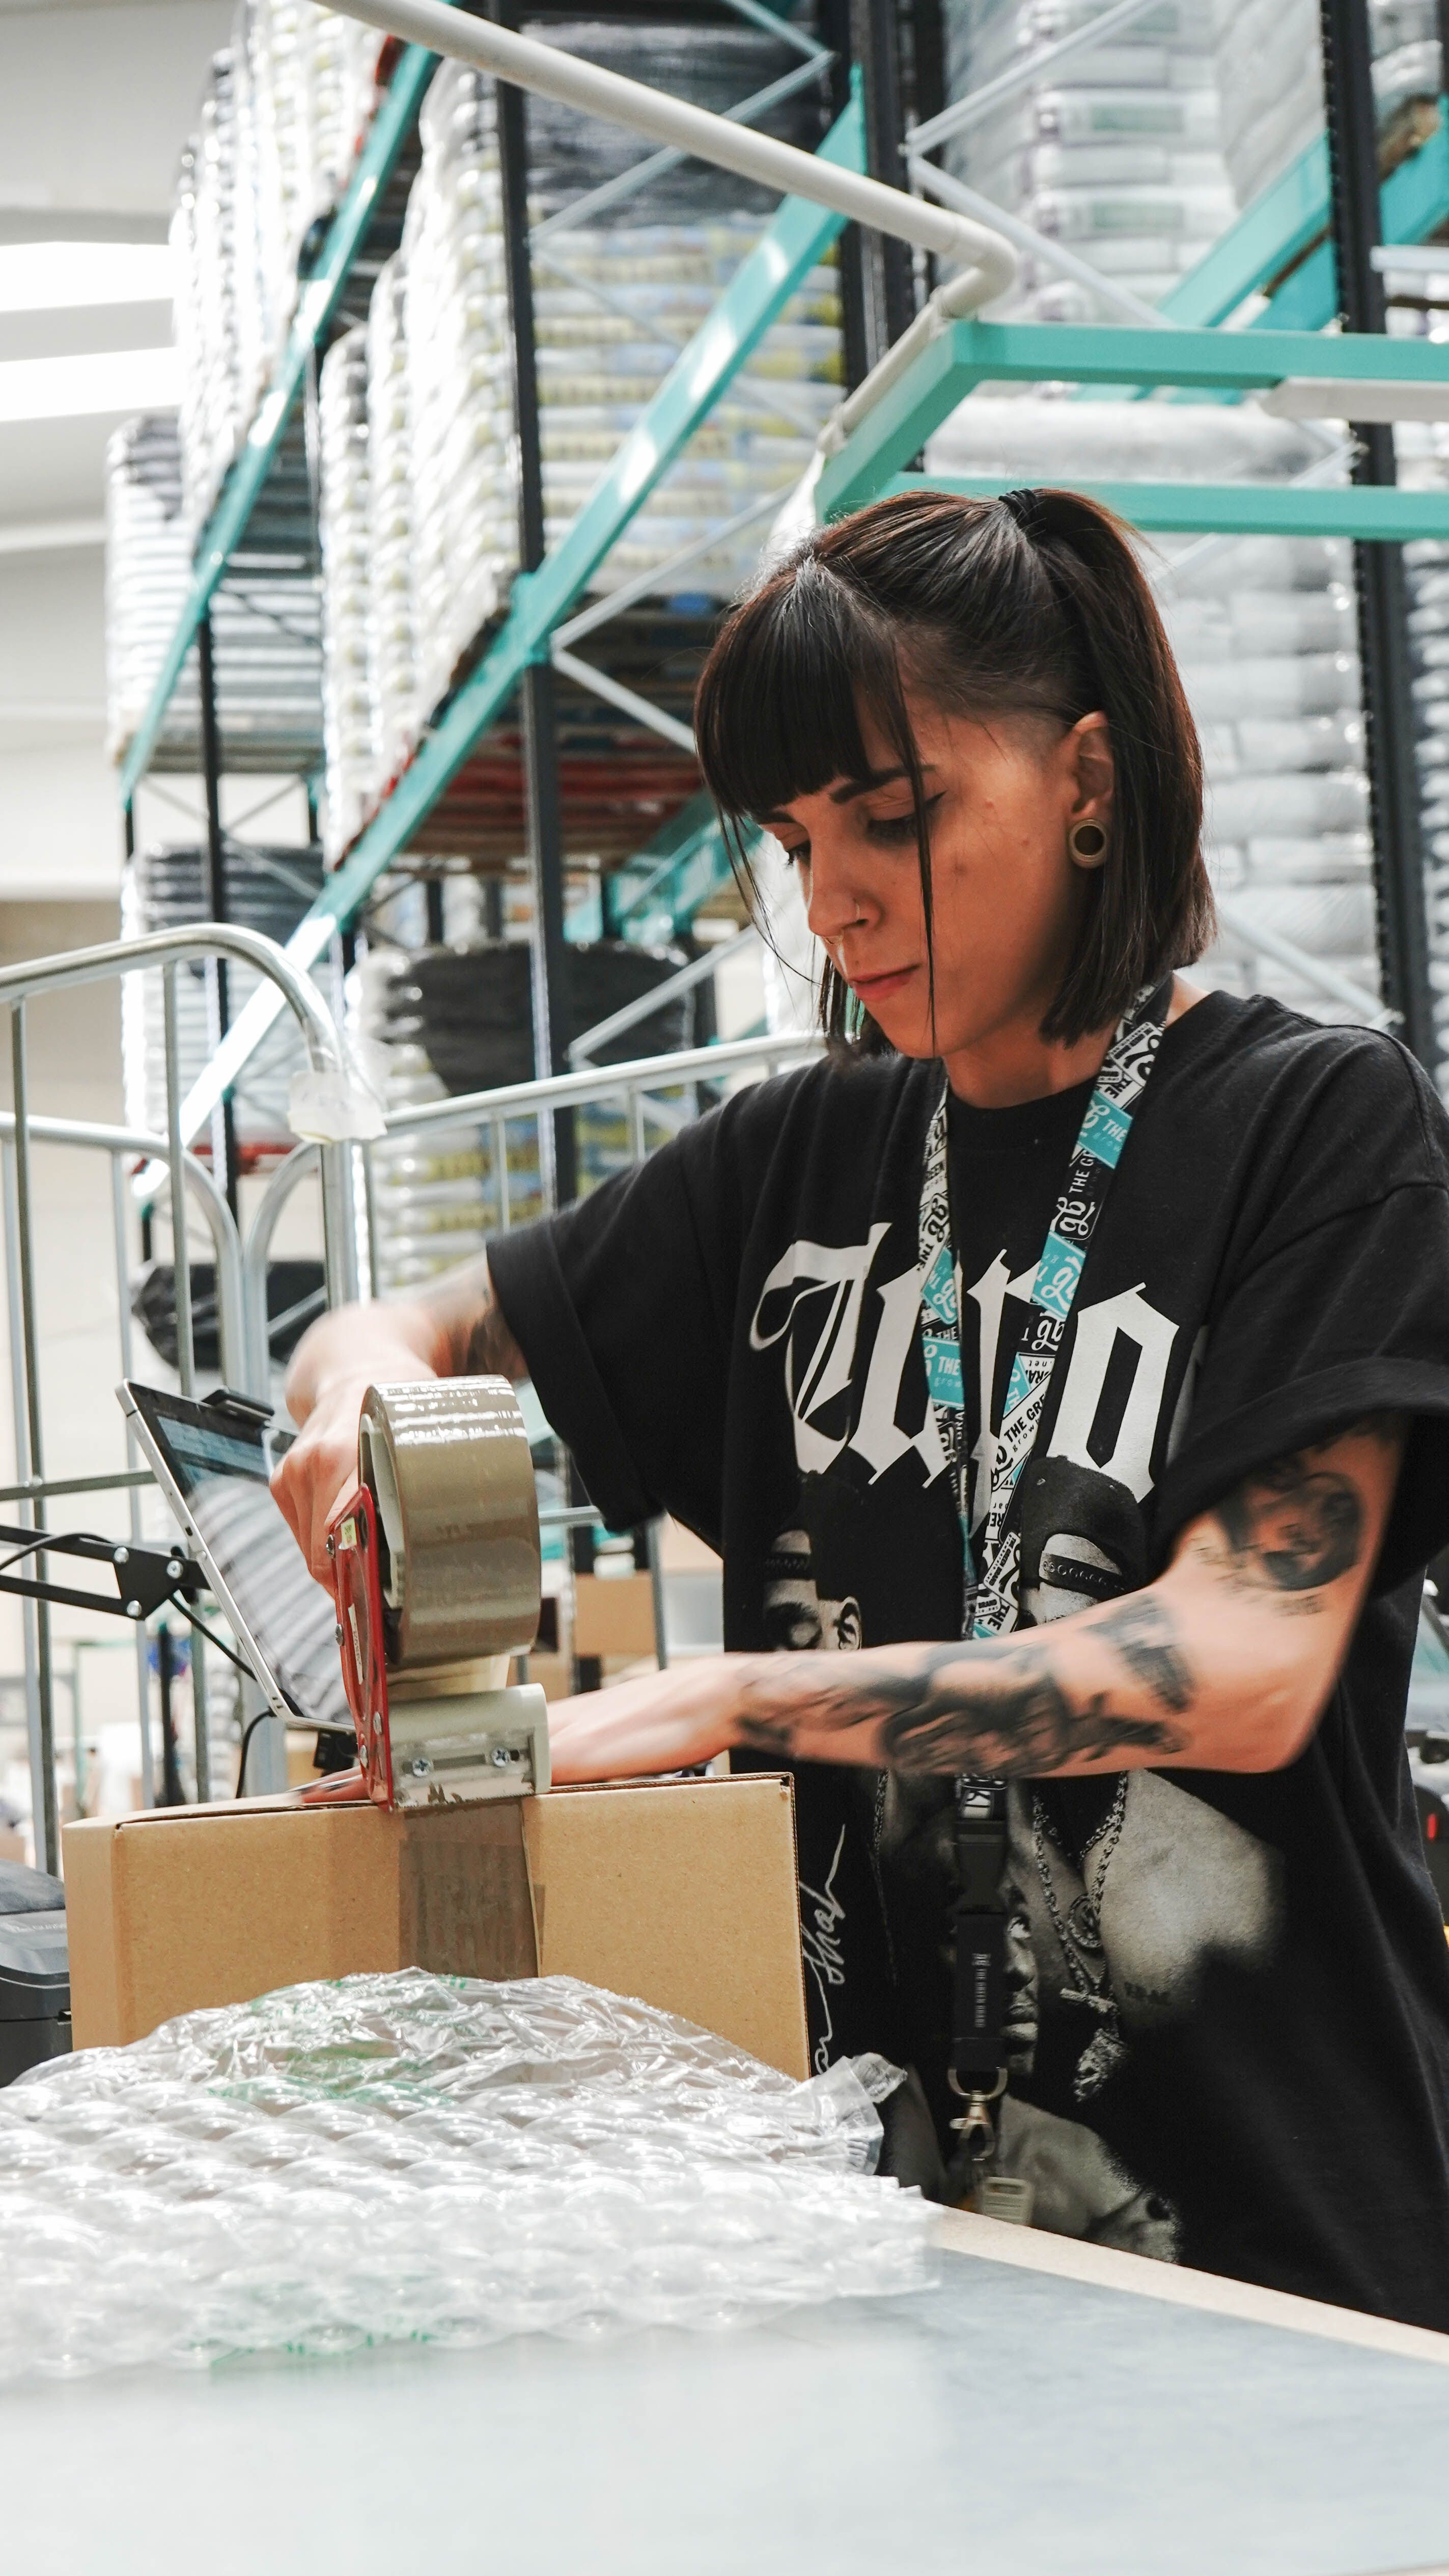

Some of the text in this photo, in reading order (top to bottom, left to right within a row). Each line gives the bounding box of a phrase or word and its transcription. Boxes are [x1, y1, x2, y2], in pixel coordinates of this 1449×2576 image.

[1068, 1170, 1090, 1193] THE
[938, 1356, 961, 1377] THE
[1004, 1416, 1027, 1443] THE
